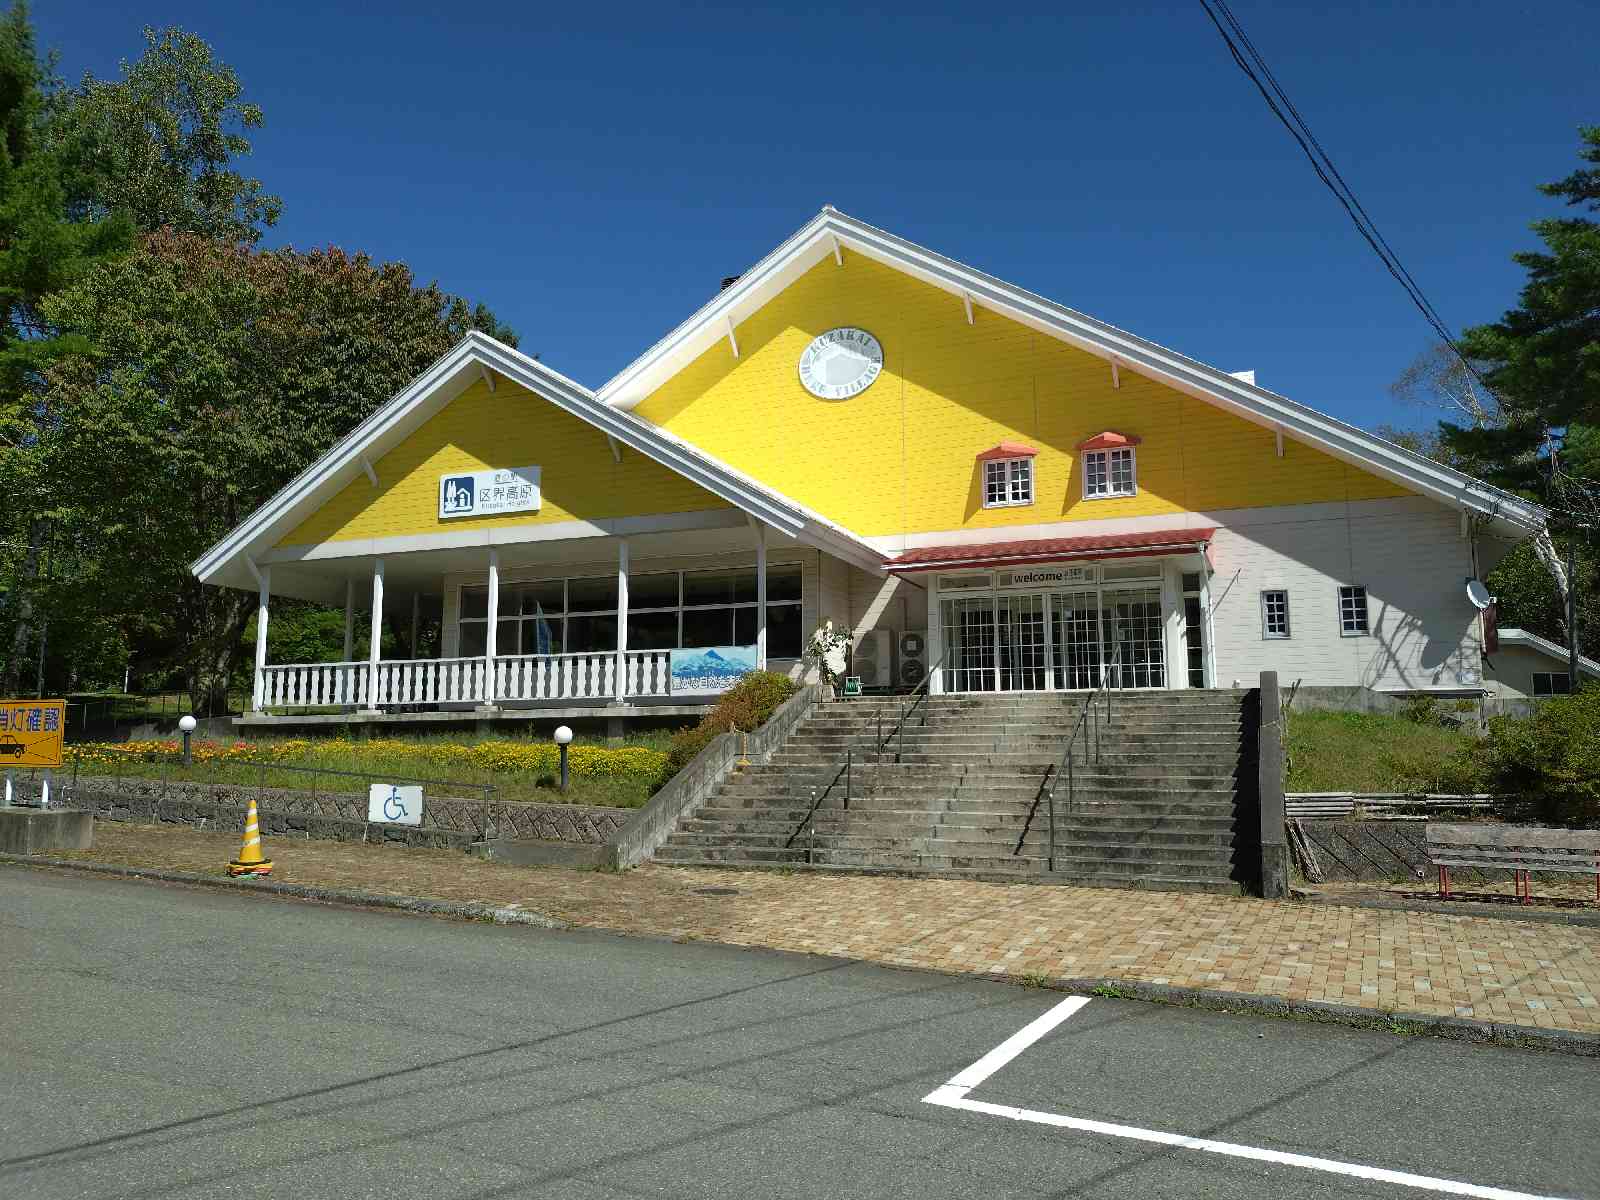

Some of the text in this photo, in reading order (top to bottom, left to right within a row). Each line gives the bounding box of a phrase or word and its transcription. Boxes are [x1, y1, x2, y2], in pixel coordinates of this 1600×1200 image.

[480, 484, 532, 502] 区界高原
[1014, 572, 1063, 583] welcome
